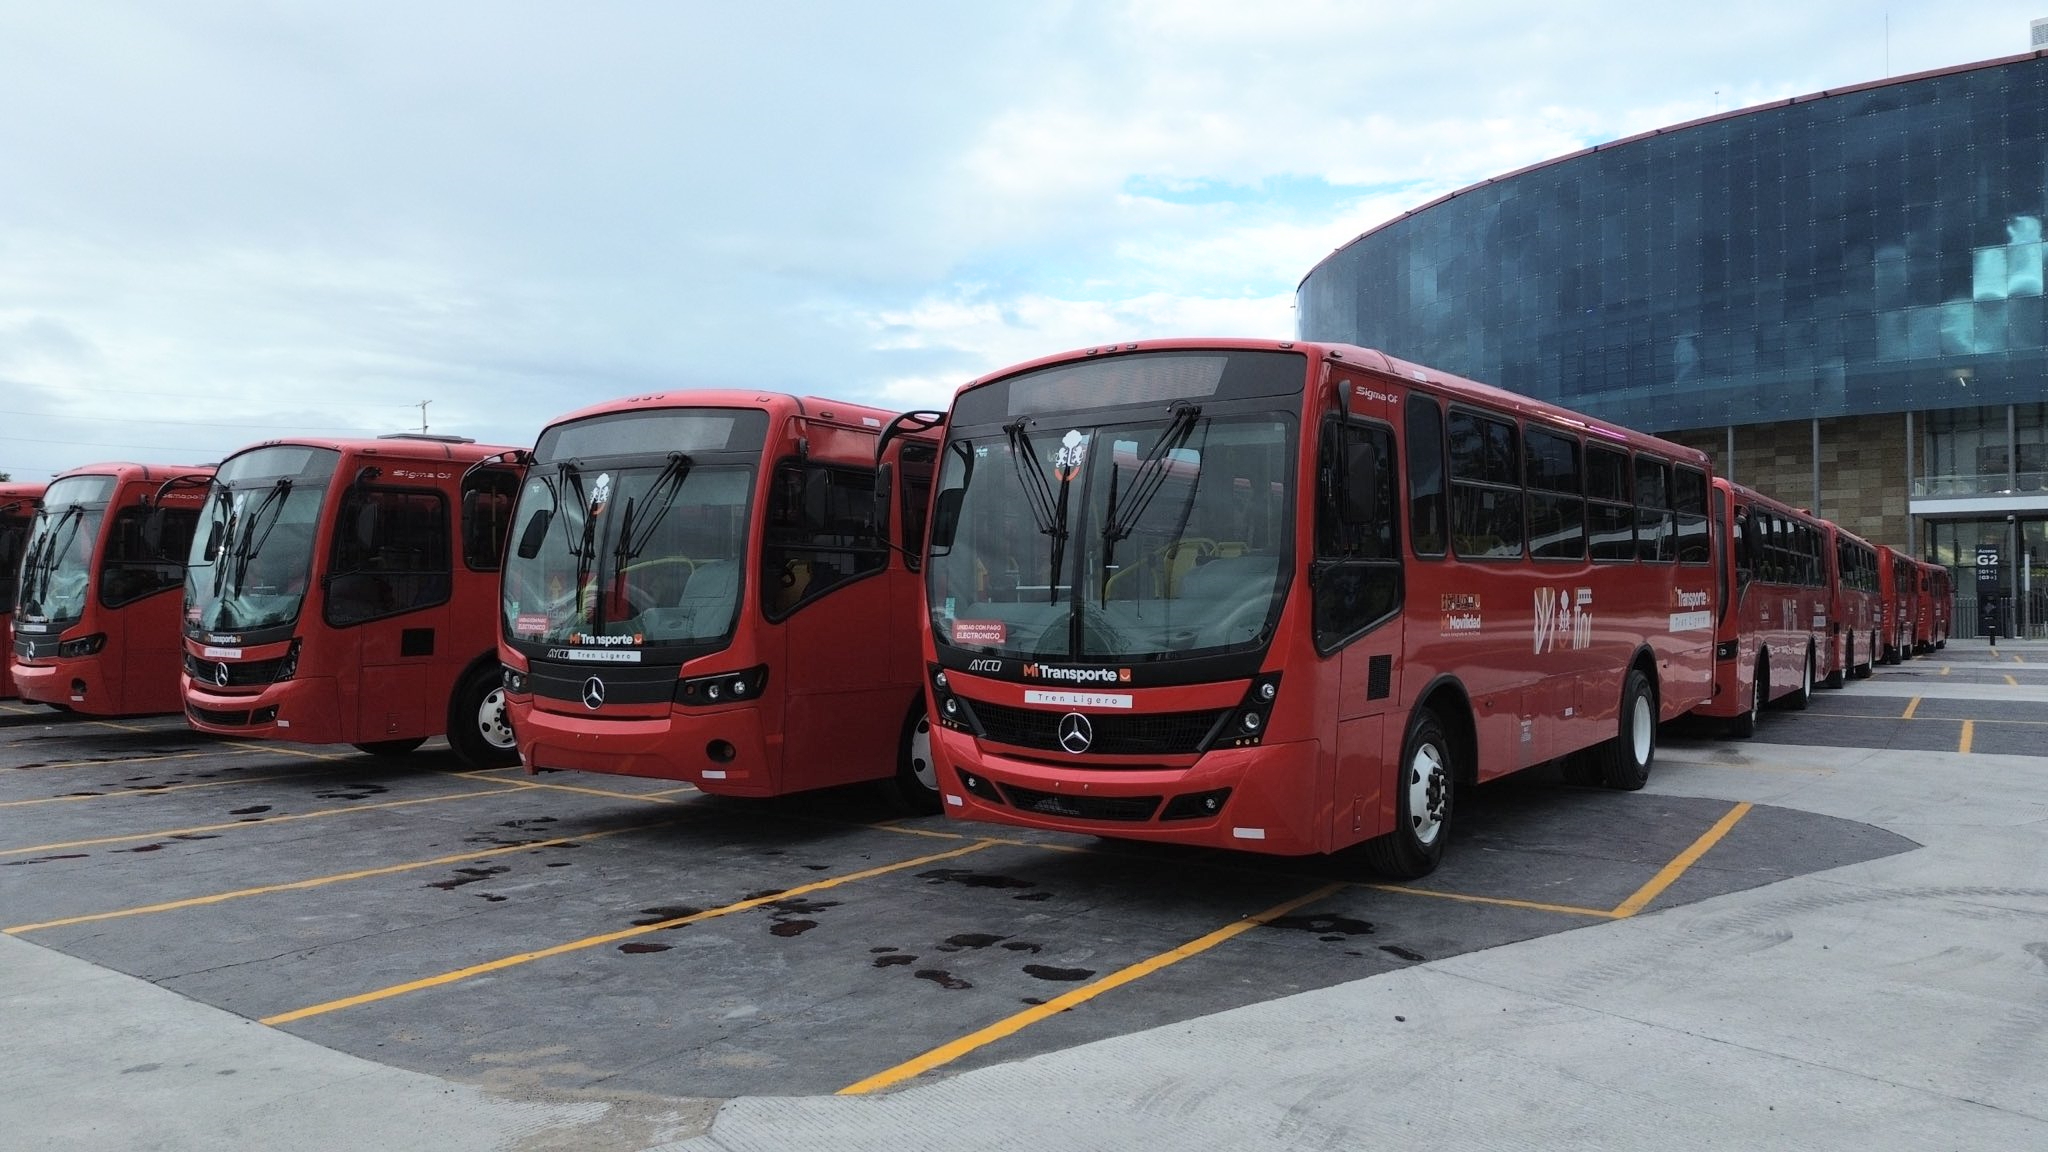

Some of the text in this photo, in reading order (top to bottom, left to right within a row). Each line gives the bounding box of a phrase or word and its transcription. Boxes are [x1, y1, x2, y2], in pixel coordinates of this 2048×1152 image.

[1355, 385, 1387, 401] Sigma
[393, 469, 435, 479] Sigma
[1977, 554, 1998, 566] G2
[1678, 588, 1707, 611] Transporte
[1450, 613, 1481, 630] Movilidad
[581, 634, 633, 647] Transporte
[956, 632, 1000, 640] ELECTRONICO
[600, 652, 631, 660] Ligero
[968, 659, 1002, 672] AYCO
[1023, 662, 1118, 683] Mi Transporte
[1038, 693, 1118, 705] Tren Ligero
